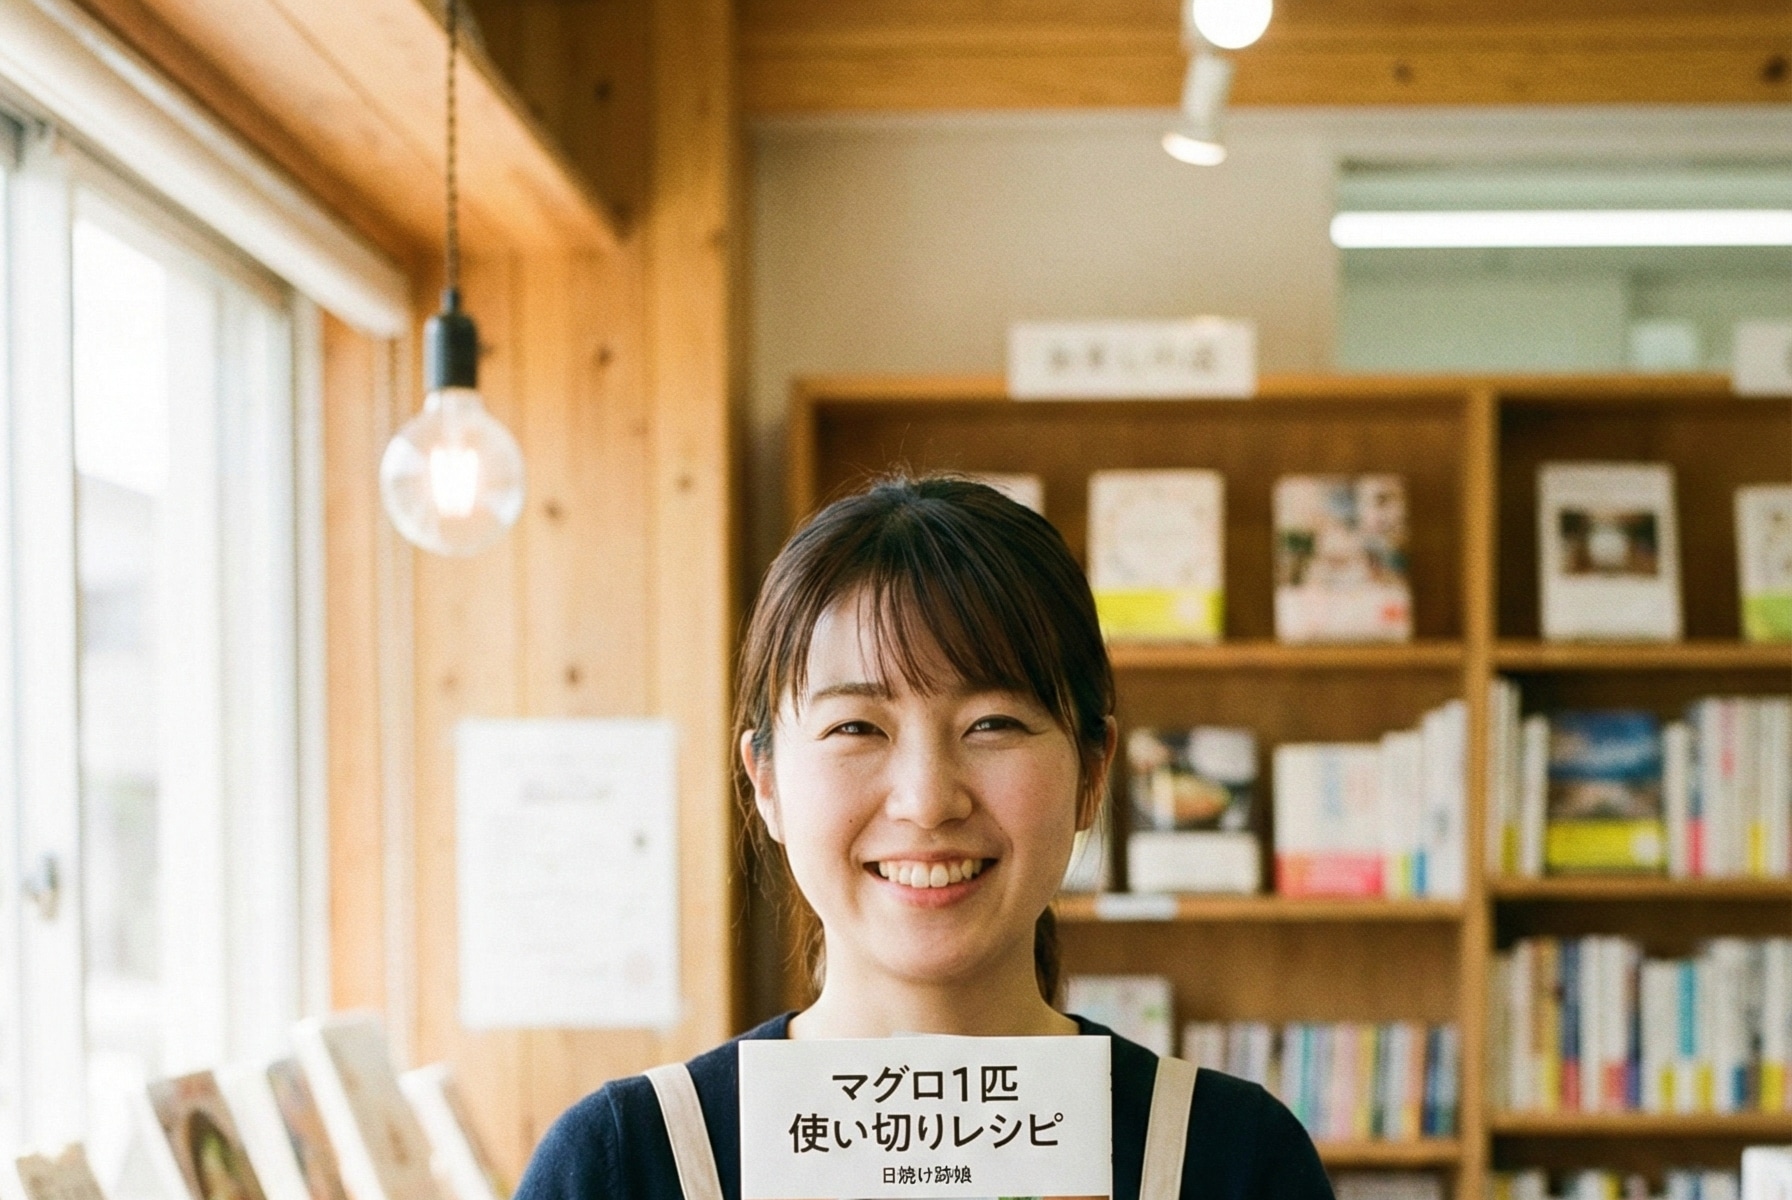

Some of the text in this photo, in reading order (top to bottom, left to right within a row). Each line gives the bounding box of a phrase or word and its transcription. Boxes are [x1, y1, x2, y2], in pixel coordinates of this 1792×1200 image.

[832, 1064, 1019, 1104] マグロ1匹
[788, 1112, 1064, 1154] 使い切りレシピ
